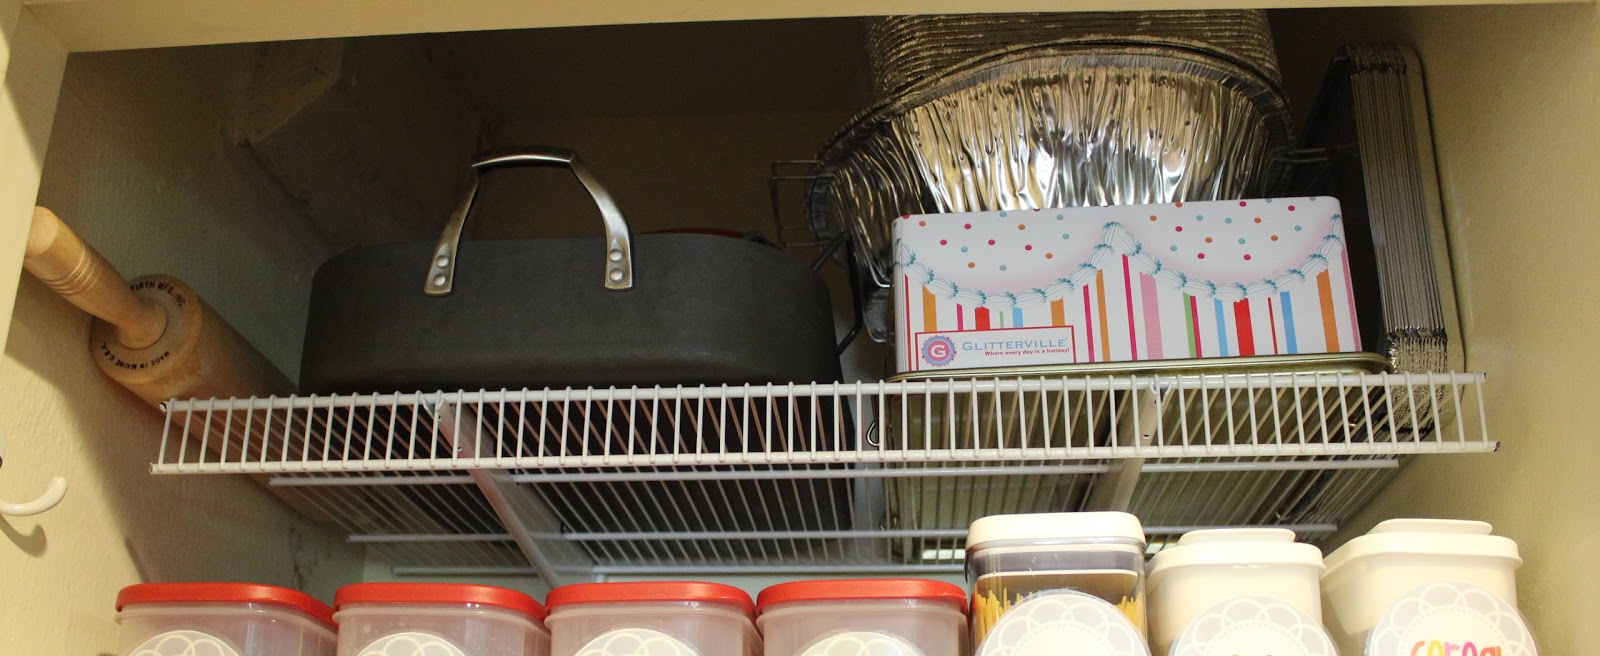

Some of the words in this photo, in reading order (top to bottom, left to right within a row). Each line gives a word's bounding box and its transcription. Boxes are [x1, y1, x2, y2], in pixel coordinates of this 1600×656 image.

[930, 344, 946, 358] G
[962, 339, 1066, 351] GLITTERVILLE
[115, 359, 138, 370] MAINE
[150, 351, 170, 366] MADE
